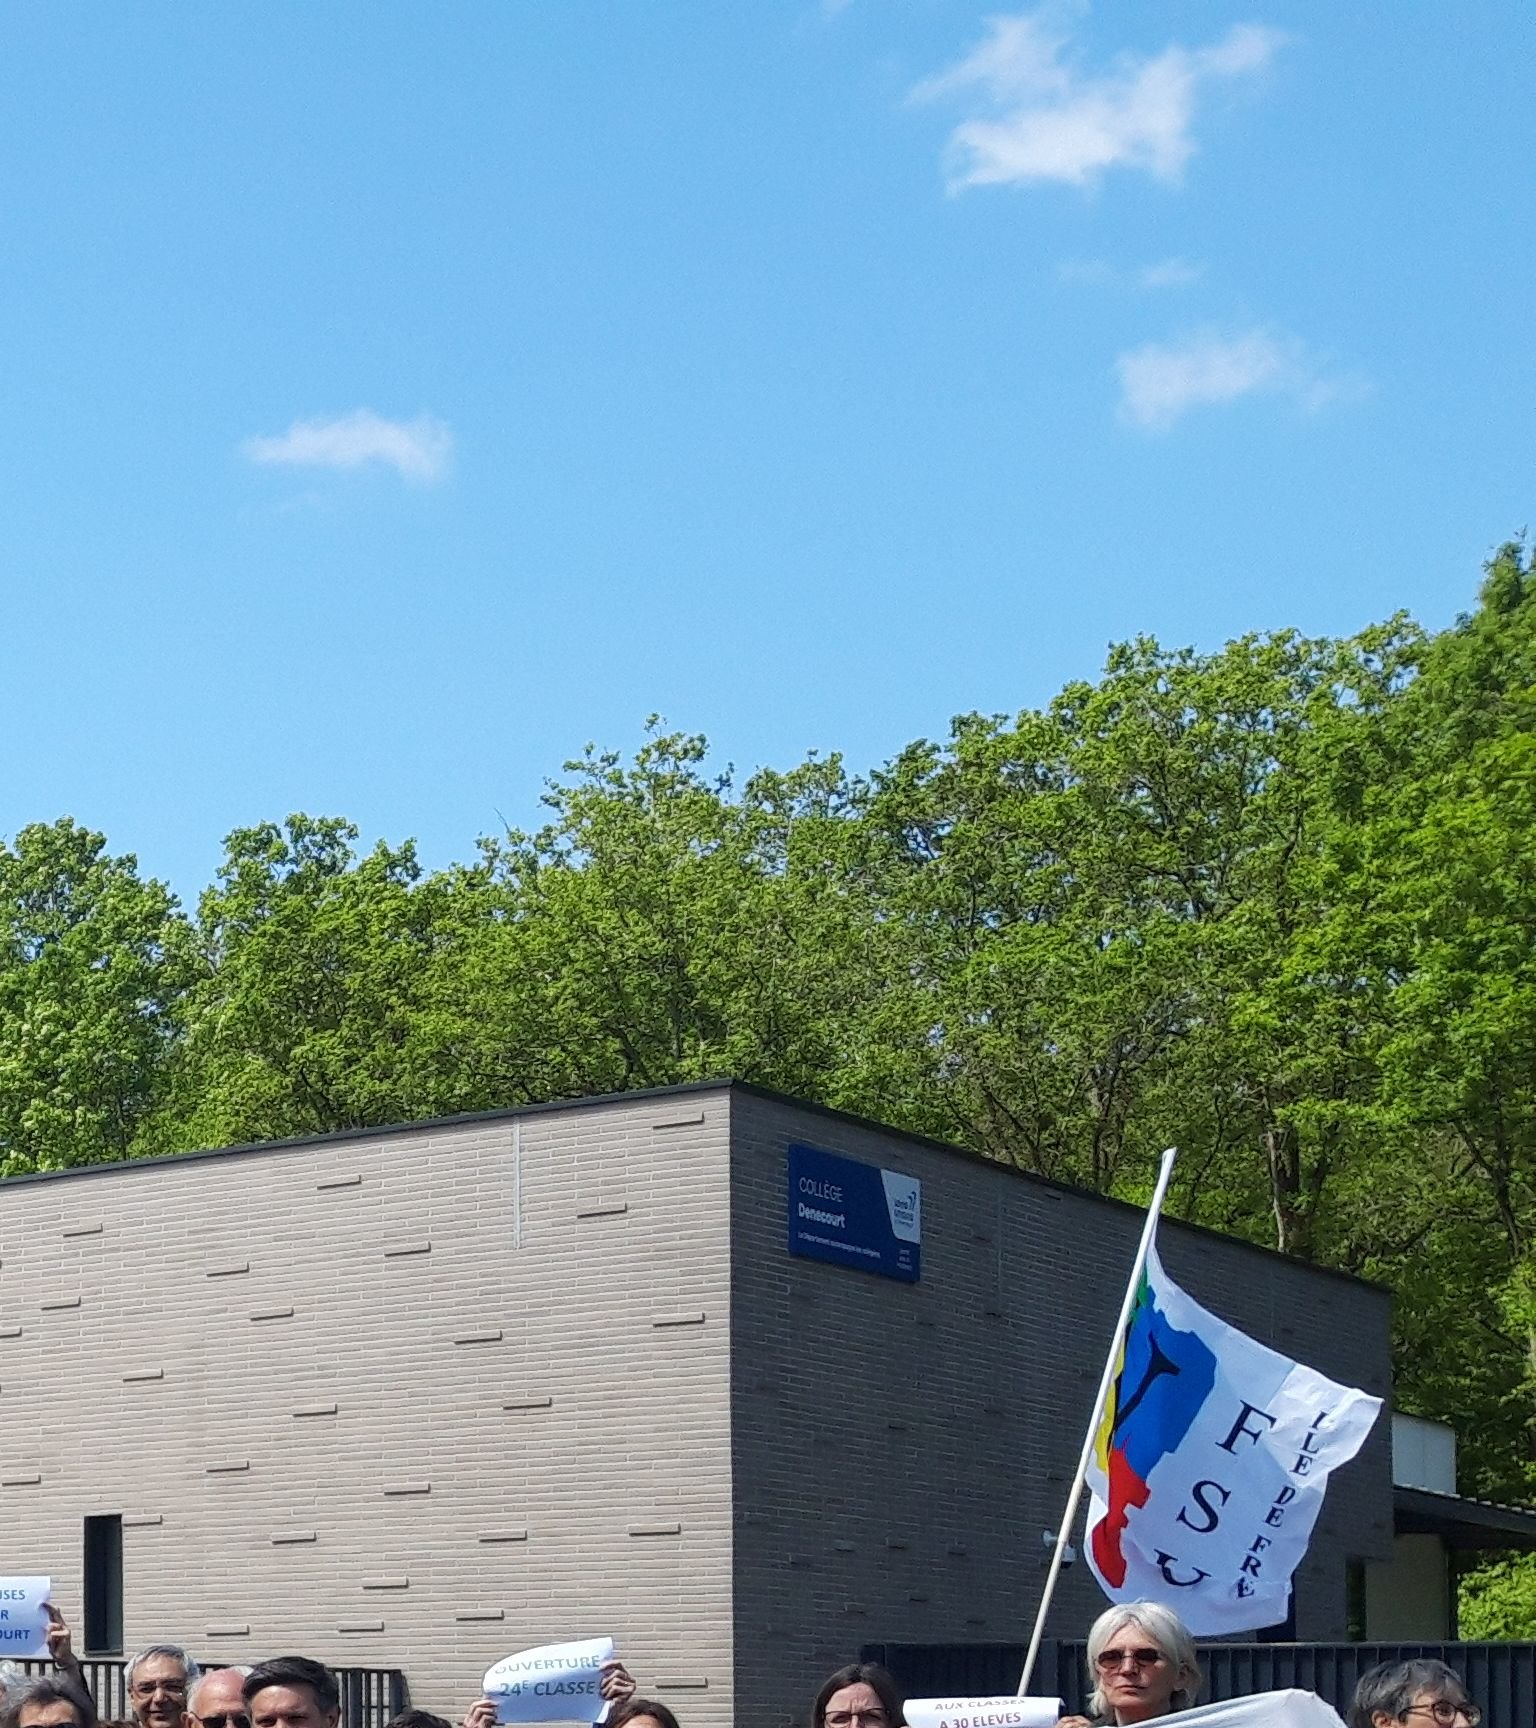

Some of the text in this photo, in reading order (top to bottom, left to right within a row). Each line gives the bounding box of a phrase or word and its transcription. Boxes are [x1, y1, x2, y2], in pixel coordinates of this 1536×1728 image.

[534, 1681, 596, 1696] CLASSE
[934, 1702, 964, 1711] AUX
[973, 1711, 1021, 1728] ELEVES
